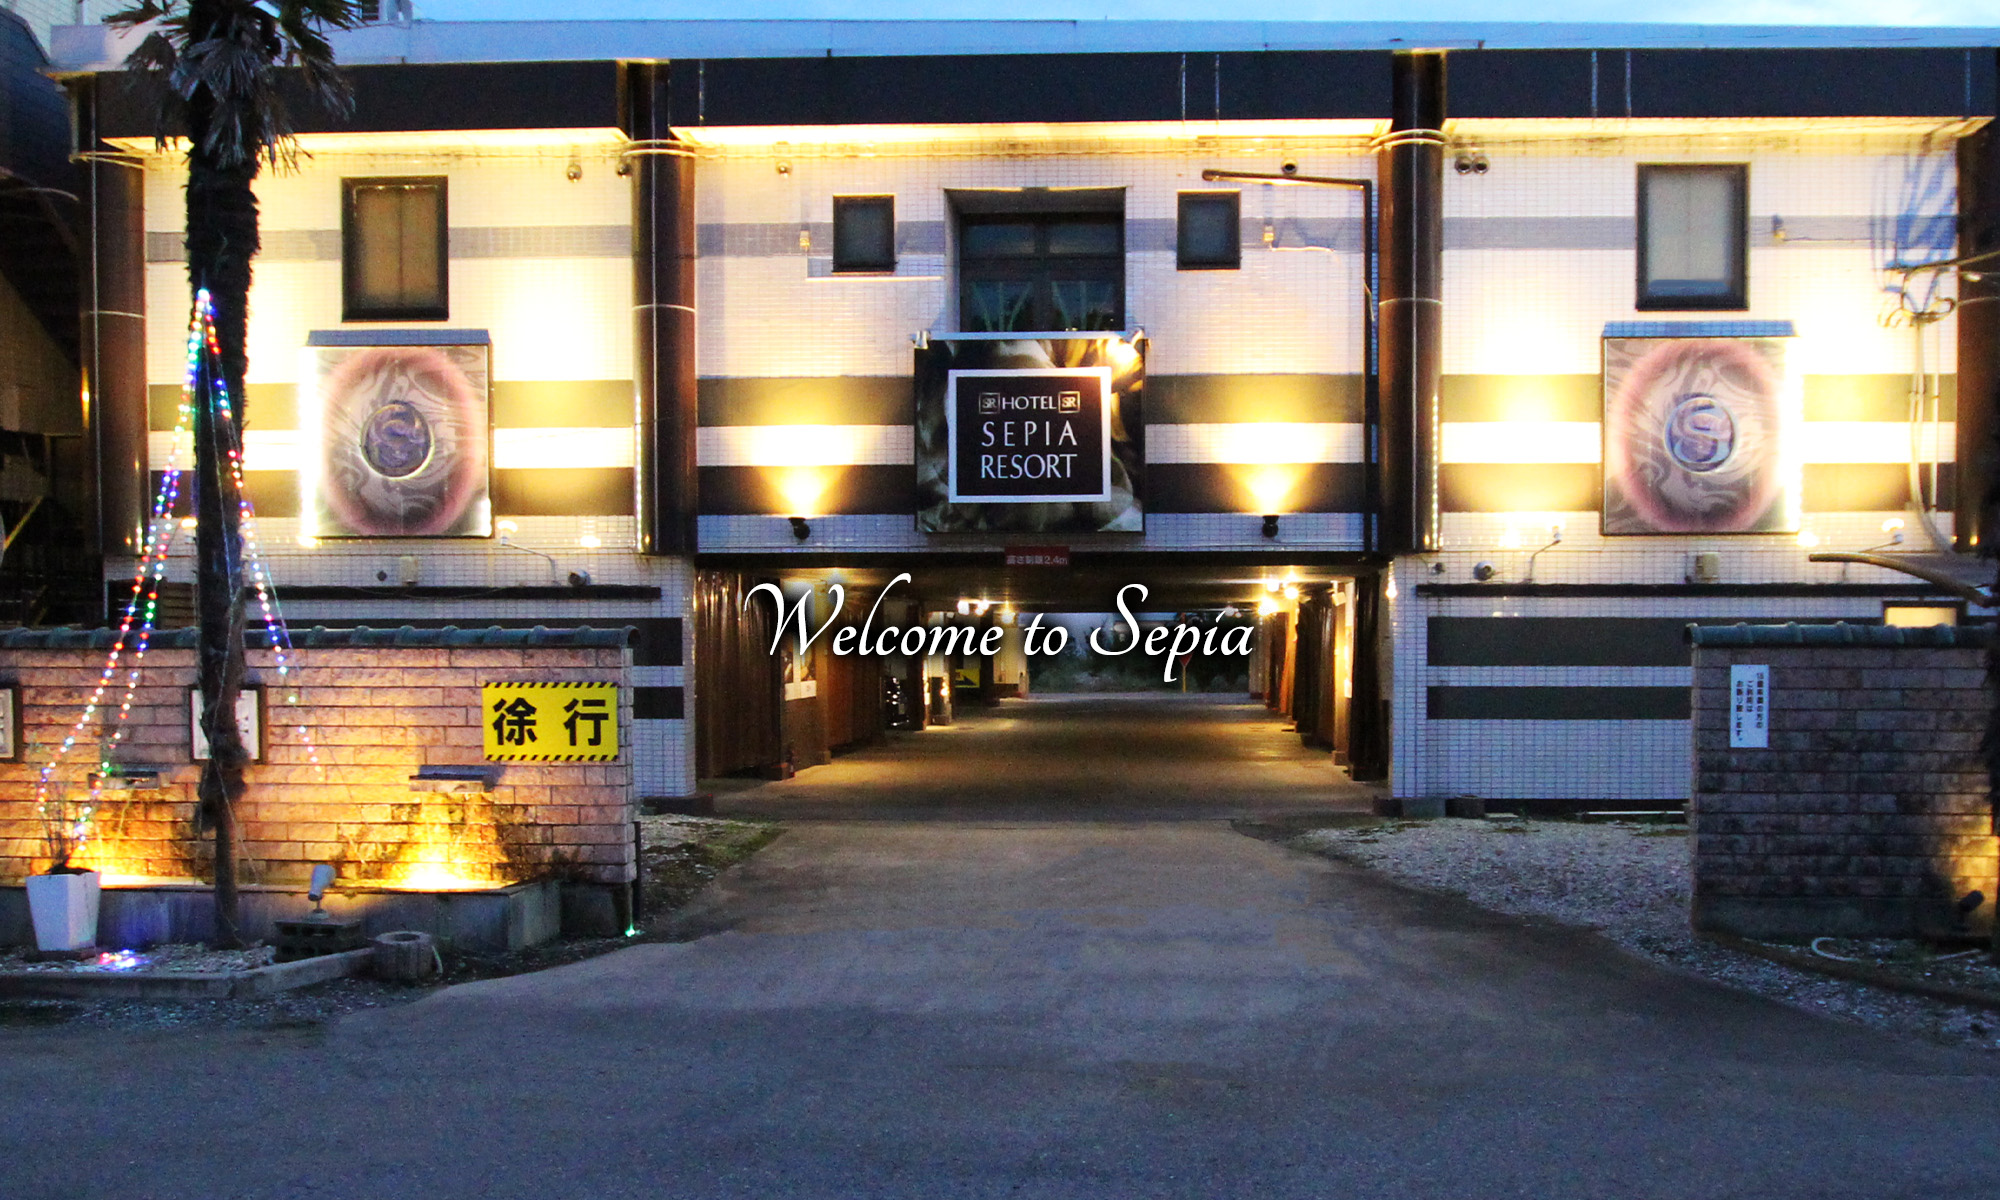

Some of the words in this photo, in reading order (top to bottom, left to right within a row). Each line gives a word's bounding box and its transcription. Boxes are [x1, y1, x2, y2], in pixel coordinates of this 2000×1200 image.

[1002, 395, 1058, 410] HOTEL
[981, 420, 1078, 447] SEPIA
[980, 454, 1078, 479] RESORT
[492, 697, 609, 746] 徐行
